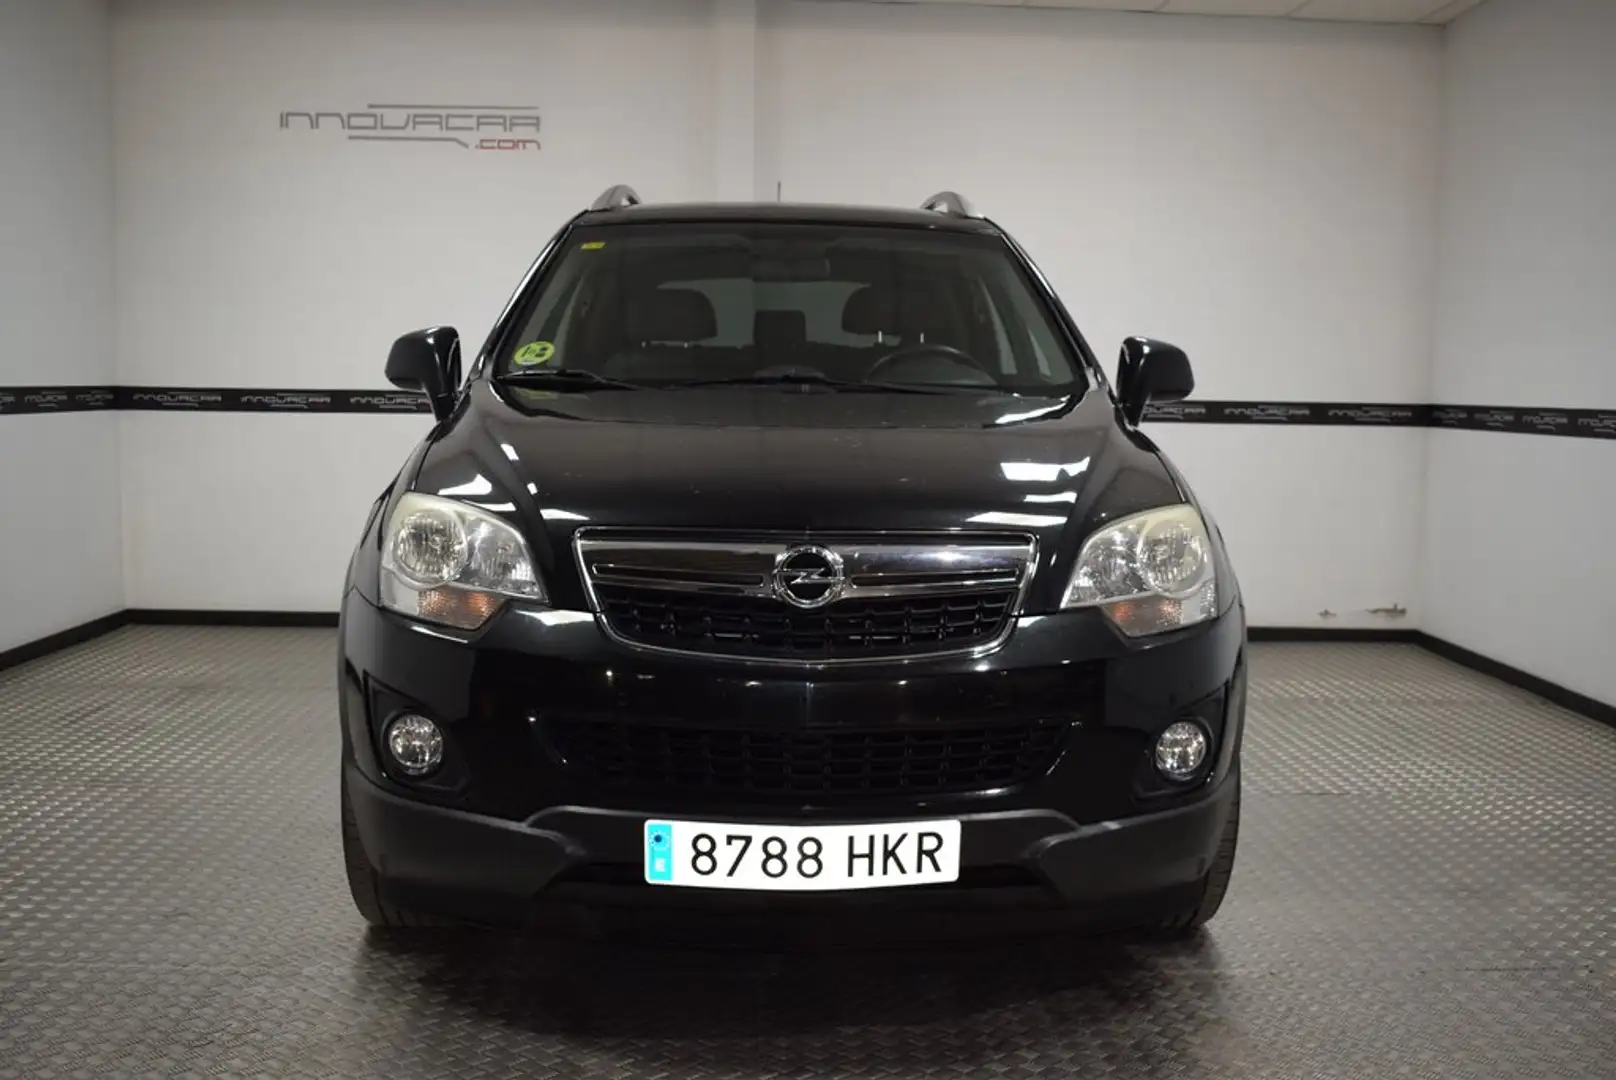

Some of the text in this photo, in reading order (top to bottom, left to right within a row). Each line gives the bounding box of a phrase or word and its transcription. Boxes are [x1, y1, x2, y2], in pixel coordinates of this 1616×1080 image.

[475, 139, 541, 150] .com
[691, 831, 944, 879] 8788 HKR
